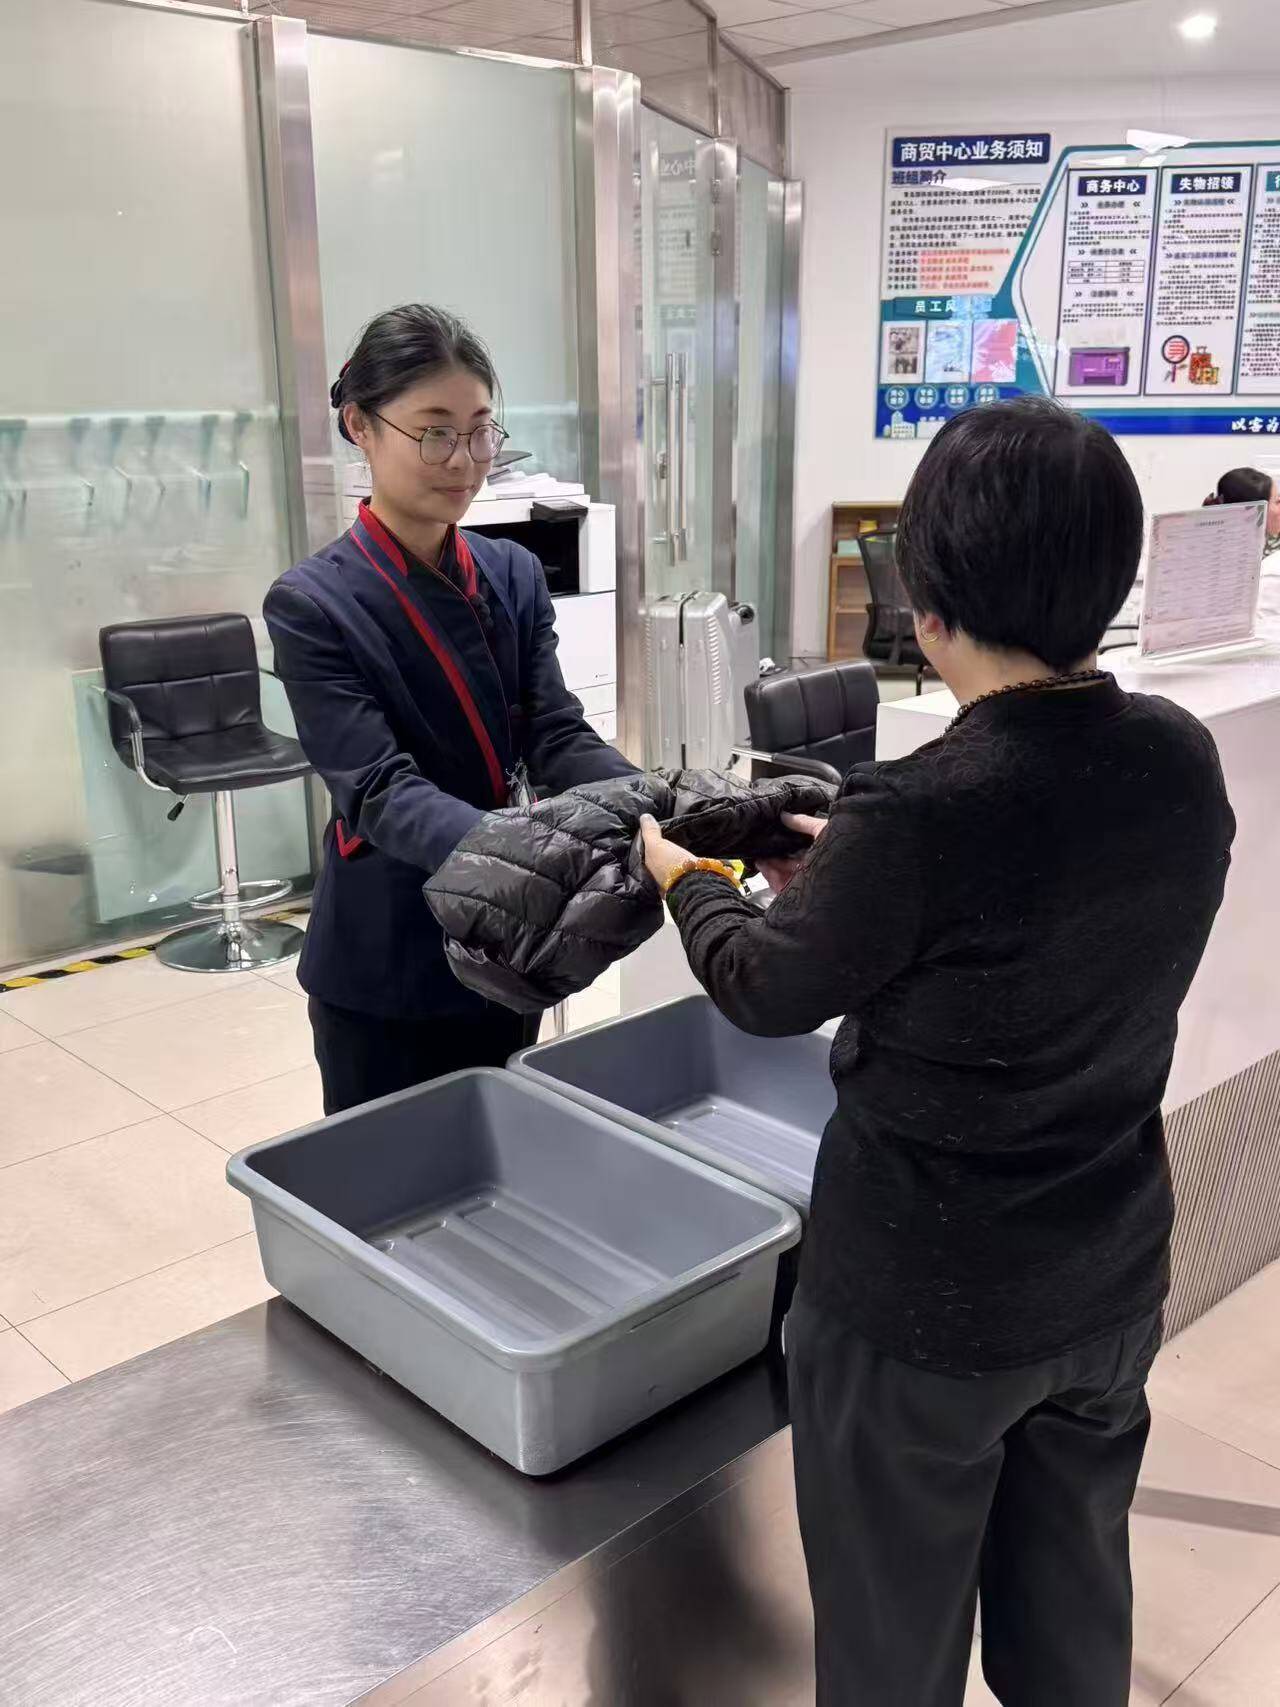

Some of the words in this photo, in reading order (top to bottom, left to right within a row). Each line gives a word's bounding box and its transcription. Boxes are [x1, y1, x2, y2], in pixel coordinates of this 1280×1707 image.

[900, 139, 1044, 162] 商贸中心业务须知
[1086, 179, 1141, 193] 商务中心
[1179, 176, 1235, 191] 失物招领
